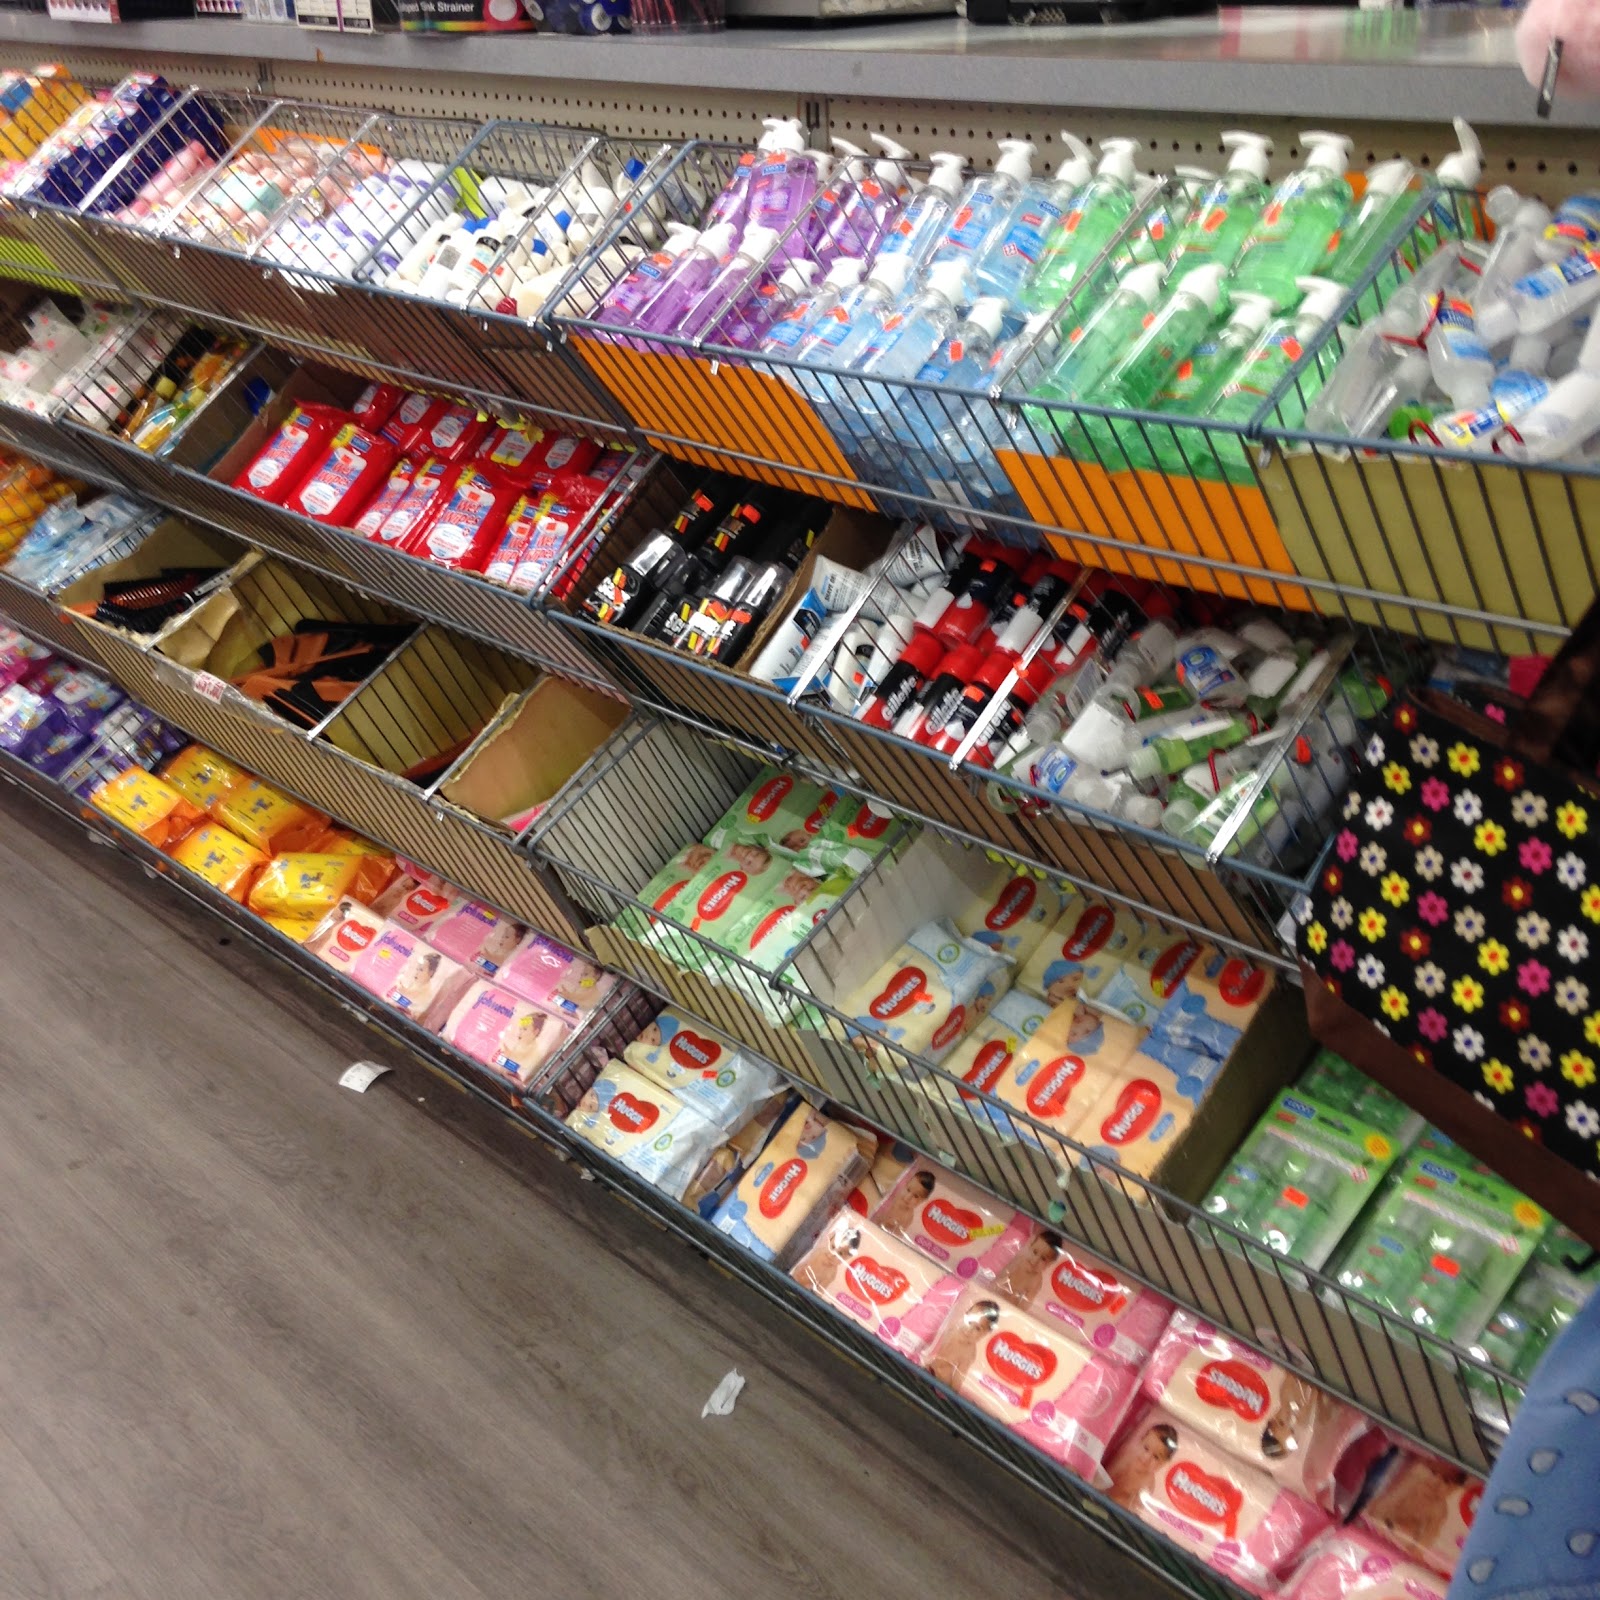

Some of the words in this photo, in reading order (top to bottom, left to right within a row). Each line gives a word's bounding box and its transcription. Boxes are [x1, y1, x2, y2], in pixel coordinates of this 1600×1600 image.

[438, 2, 475, 12] Strainer
[882, 675, 918, 721] Gillette
[754, 780, 788, 815] HUGGIES
[703, 874, 742, 913] HUGGIES
[991, 884, 1032, 927] HUGGIES
[1069, 913, 1108, 958] HUGGIES
[876, 976, 922, 1016] HUGGIES
[675, 1036, 710, 1065] HUGGIES
[1033, 1059, 1078, 1108] HUGGIES
[613, 1098, 644, 1126] HUGGIE
[1108, 1101, 1147, 1142] HUGGI
[769, 1163, 802, 1203] HUGGIE
[927, 1204, 970, 1240] HUGGIES
[853, 1262, 894, 1299] HUGGIES
[1057, 1267, 1105, 1304] HUGGIES
[992, 1337, 1045, 1380] HUGGIES
[1209, 1367, 1265, 1414] HUGGIES
[1171, 1468, 1227, 1517] HUGGIES
